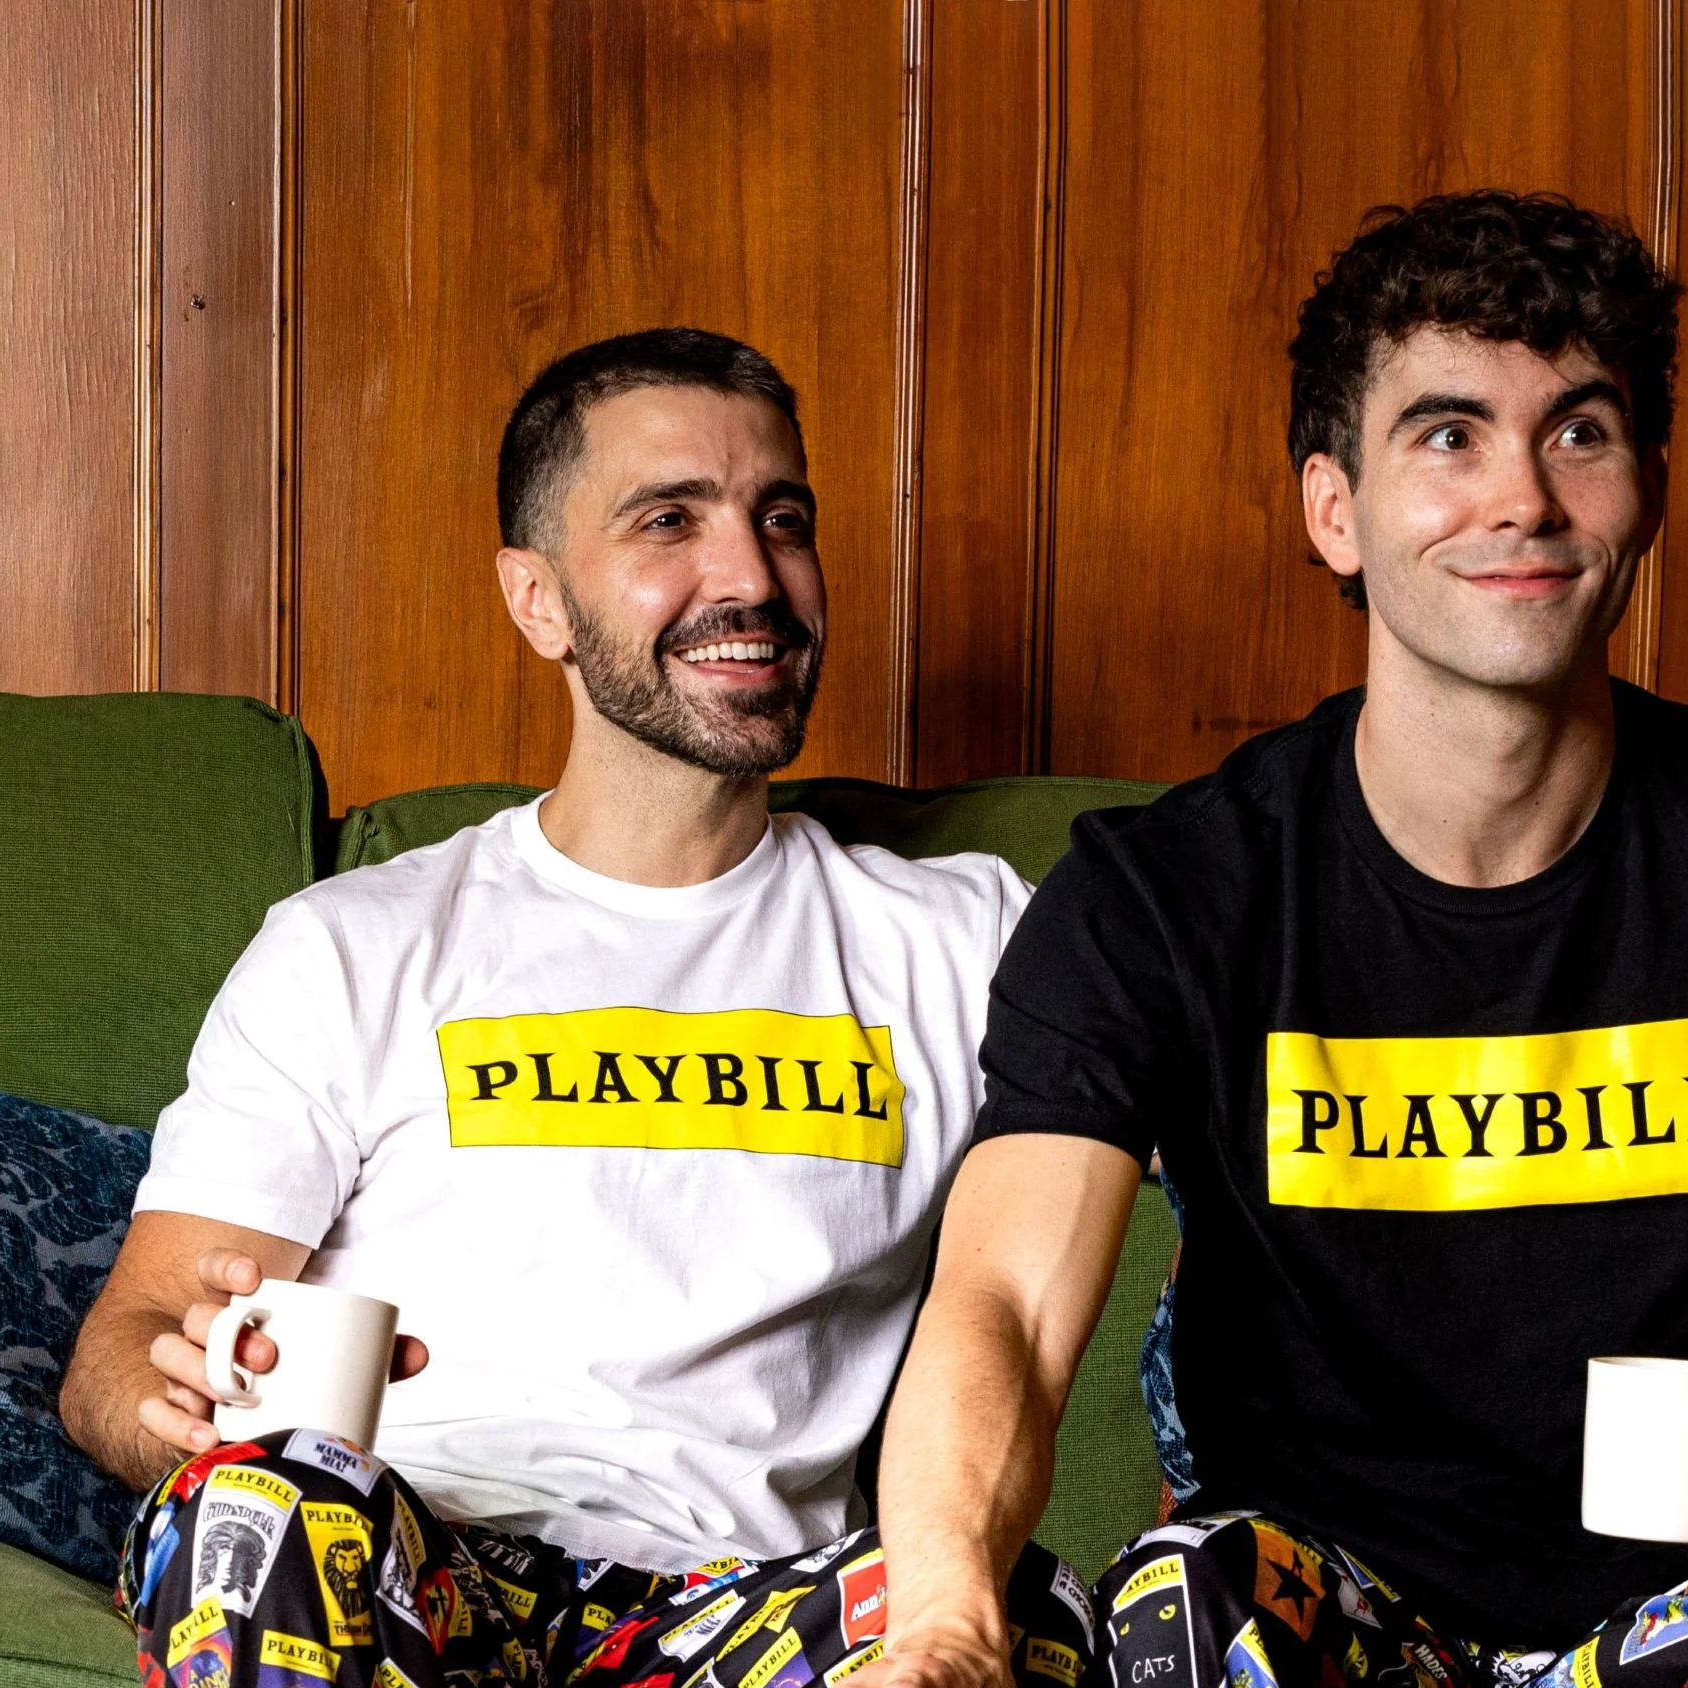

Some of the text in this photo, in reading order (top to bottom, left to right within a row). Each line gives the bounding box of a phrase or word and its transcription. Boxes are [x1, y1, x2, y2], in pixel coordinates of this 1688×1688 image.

[465, 1051, 888, 1121] PLAYBILL
[215, 1470, 292, 1502] PLAYBILL
[1127, 1563, 1179, 1593] AYBILL
[1132, 1654, 1175, 1684] CATS
[1415, 1644, 1448, 1680] HADES
